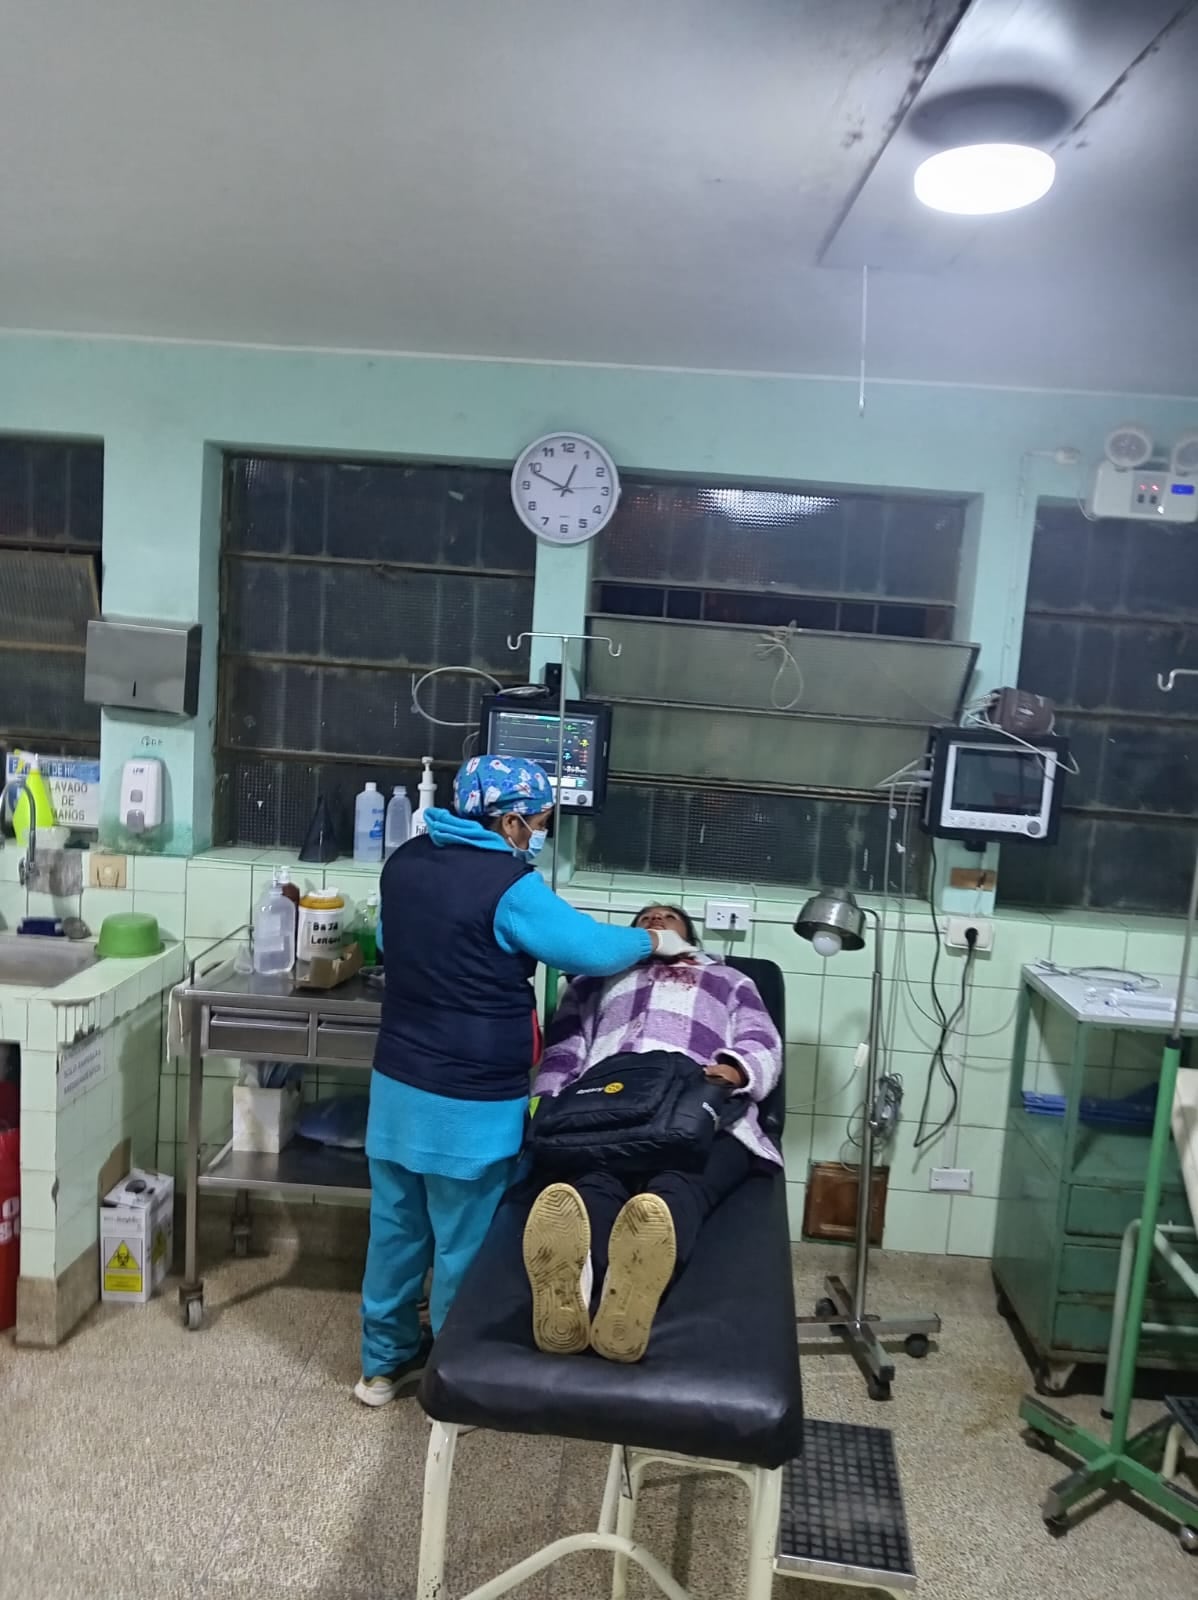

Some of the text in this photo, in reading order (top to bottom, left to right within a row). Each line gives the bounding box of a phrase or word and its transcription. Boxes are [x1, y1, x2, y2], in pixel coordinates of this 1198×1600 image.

[542, 447, 554, 457] 11
[560, 443, 575, 453] 12
[584, 450, 590, 460] 1
[528, 462, 542, 473] 10
[596, 467, 605, 477] 2
[522, 481, 531, 490] 9
[601, 487, 609, 496] 3
[528, 501, 536, 511] 8
[592, 505, 602, 514] 4
[541, 516, 549, 526] 7
[578, 519, 588, 528] 5
[560, 524, 568, 533] 6
[48, 781, 88, 793] LAVADO
[61, 795, 75, 807] DE
